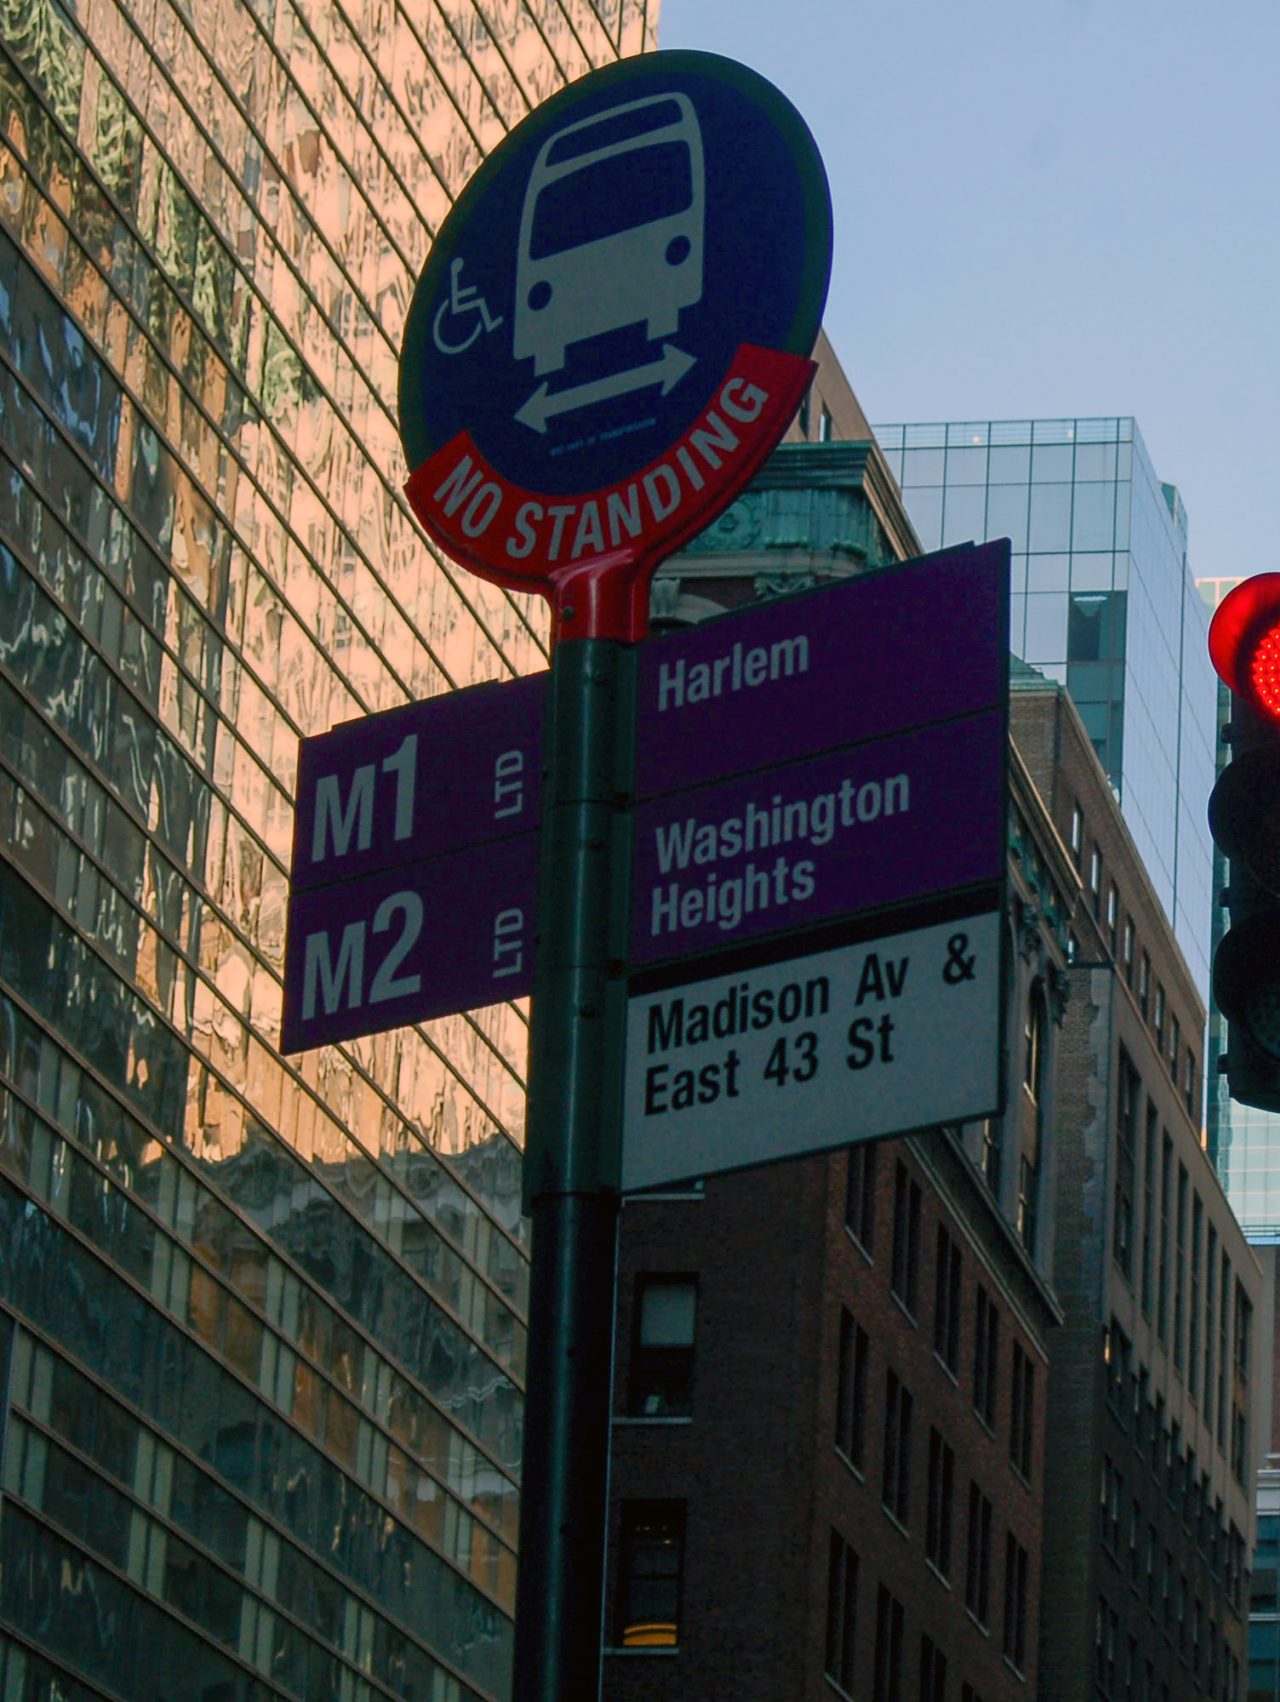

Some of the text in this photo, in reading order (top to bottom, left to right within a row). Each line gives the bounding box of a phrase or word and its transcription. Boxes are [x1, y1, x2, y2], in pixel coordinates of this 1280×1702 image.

[433, 377, 769, 561] NO STANDING
[657, 635, 810, 712] Harlem
[310, 733, 420, 862] M1
[494, 749, 523, 819] LTD
[655, 773, 911, 874] Washington
[493, 907, 523, 977] LTD
[649, 857, 816, 934] Heights
[301, 890, 424, 1021] M2
[646, 933, 977, 1054] Madison Av &
[643, 1014, 895, 1117] East 43 St
